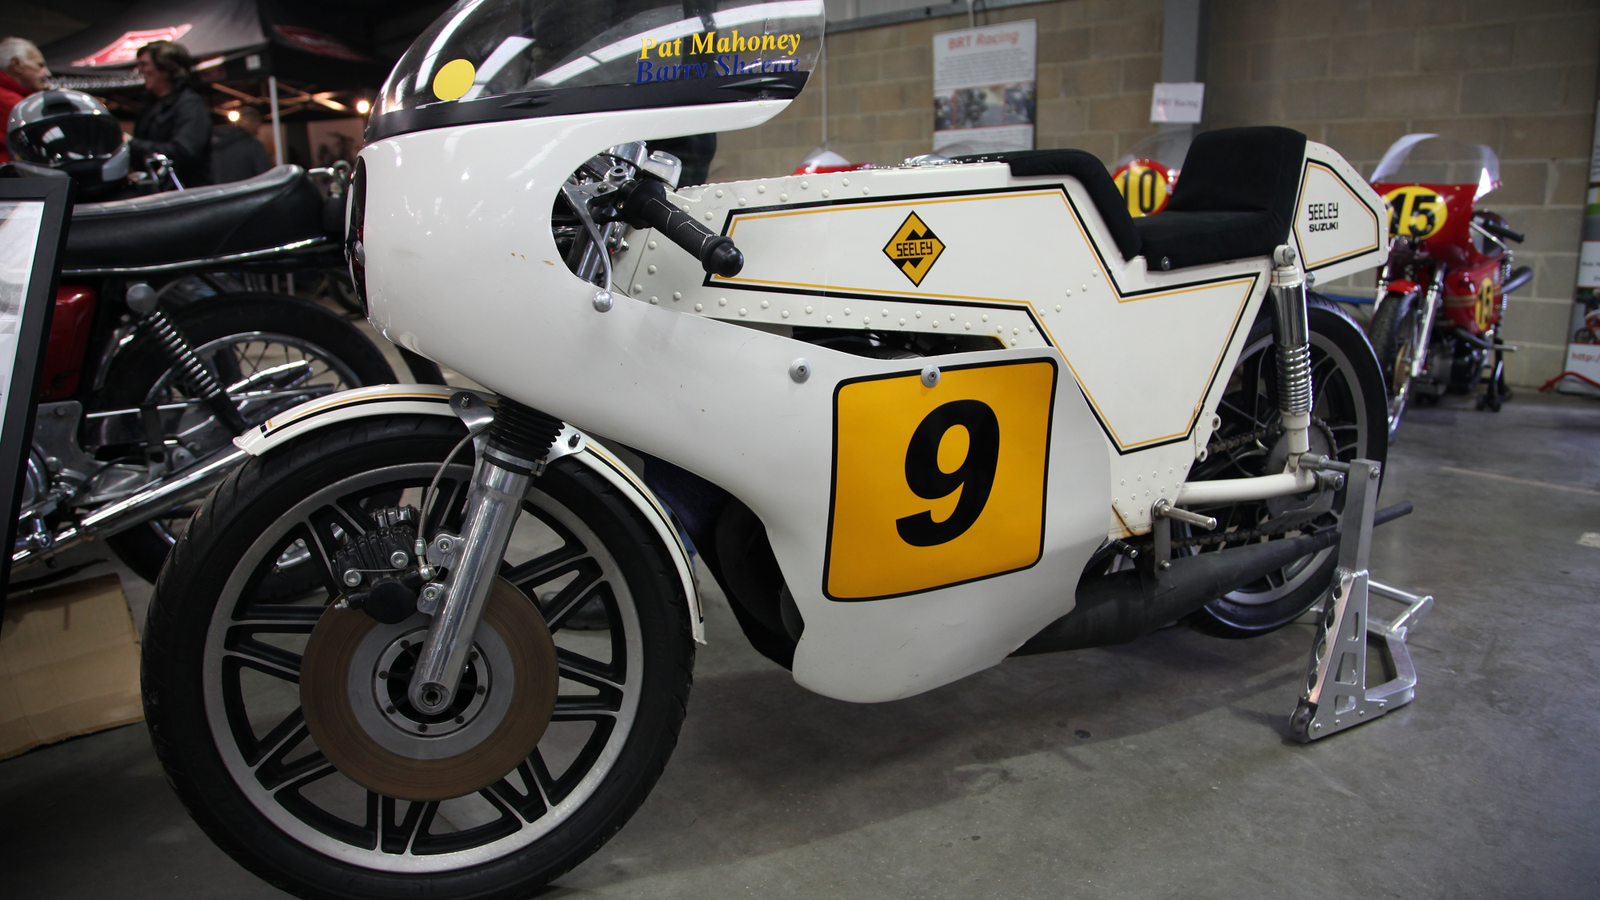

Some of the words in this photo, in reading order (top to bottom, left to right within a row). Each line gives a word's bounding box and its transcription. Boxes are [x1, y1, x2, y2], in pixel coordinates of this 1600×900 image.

[639, 36, 682, 60] Pat
[689, 30, 801, 56] Mahoney
[948, 34, 973, 51] BRT
[975, 30, 1020, 46] Racing
[635, 60, 708, 84] Barry
[714, 53, 800, 77] Sheene
[1122, 168, 1157, 214] 10
[1308, 202, 1339, 221] SEELEY
[1386, 192, 1437, 236] 15
[1308, 221, 1339, 233] SUZUKI
[896, 240, 933, 257] SEELEY
[895, 398, 1001, 548] 9
